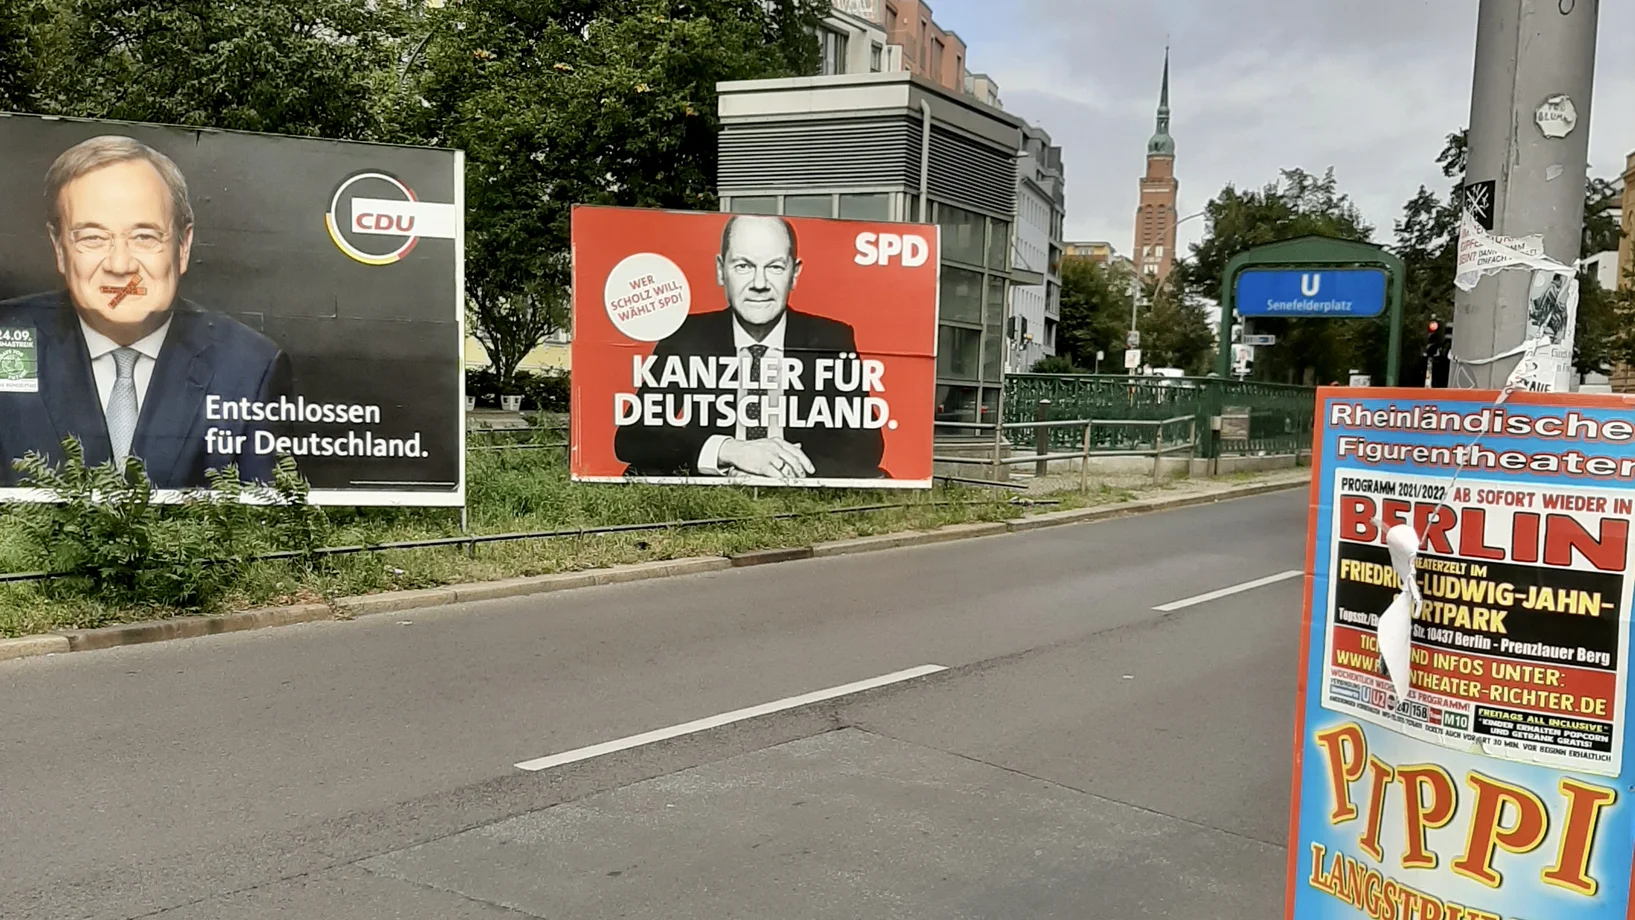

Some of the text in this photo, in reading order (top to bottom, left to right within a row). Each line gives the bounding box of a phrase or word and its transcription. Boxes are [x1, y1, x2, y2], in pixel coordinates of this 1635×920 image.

[355, 212, 415, 232] CDU
[854, 232, 928, 267] SPD
[611, 281, 683, 311] SCHOLZ WILL,
[629, 275, 655, 290] WER
[1301, 273, 1321, 297] U
[618, 292, 683, 321] WÄHLT SPD!
[1266, 299, 1353, 314] Senefelderplatz
[632, 351, 886, 393] KANZLER FÜR
[205, 395, 381, 423] Entschlossen
[613, 392, 899, 430] DEUTSCHLAND.
[1331, 403, 1634, 441] Rheinländische
[205, 428, 430, 459] für Deutschland.
[1338, 436, 1635, 477] Figurentheater
[1341, 477, 1633, 515] PROGRAMM 2021/2022 AB SOFORT WIEDER IN
[1339, 493, 1631, 572] BERLIN
[1470, 564, 1488, 578] IM
[1341, 558, 1615, 617] FRIEDRI-LUDWIG-JAHN-
[1427, 627, 1454, 644] 10437
[1454, 631, 1492, 650] Berlin
[1500, 637, 1575, 660] Prenzlauer
[1576, 646, 1611, 666] Berg
[1433, 652, 1484, 676] INFOS
[1491, 661, 1566, 688] UNTER:
[1444, 713, 1468, 729] M10
[1516, 723, 1562, 736] ERHALTEN
[1563, 729, 1609, 743] POPCORN
[1526, 714, 1546, 725] ALL
[1523, 743, 1537, 752] VOR
[1556, 737, 1593, 748] GRATIS!
[1314, 721, 1617, 896] PIPPI
